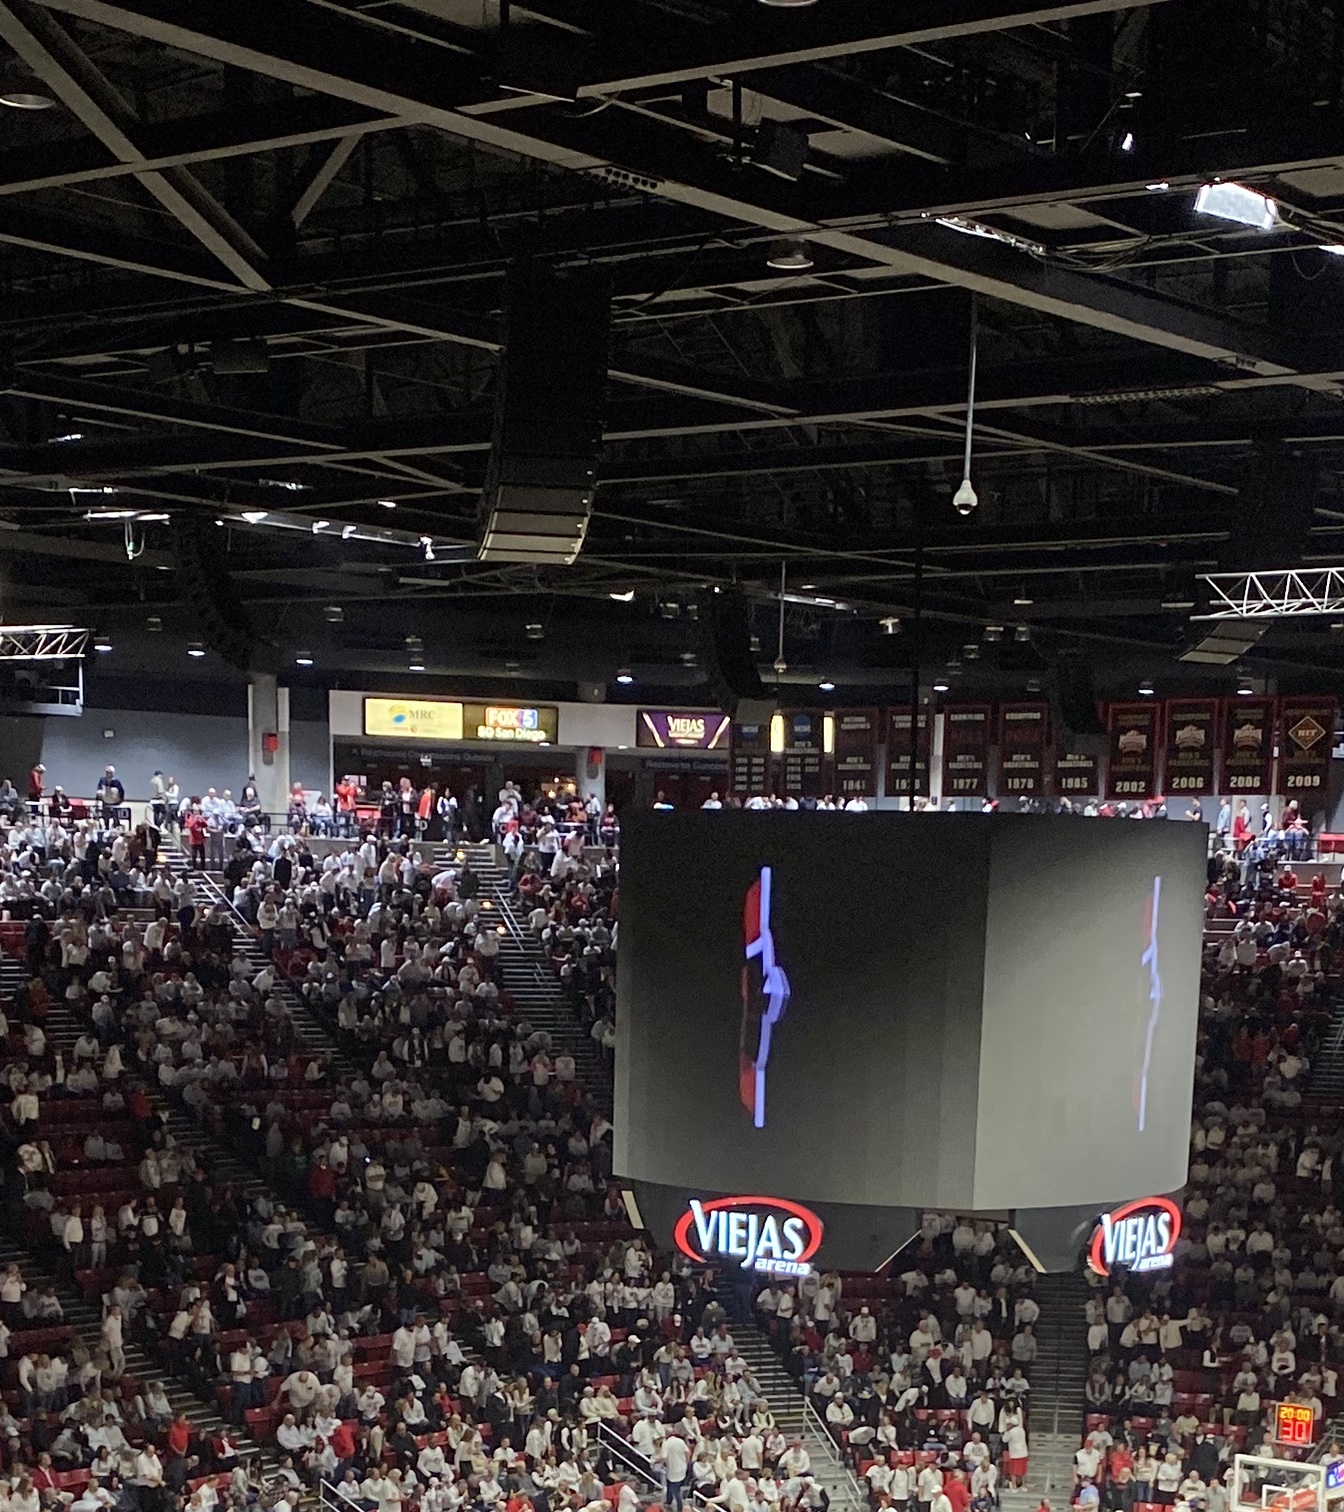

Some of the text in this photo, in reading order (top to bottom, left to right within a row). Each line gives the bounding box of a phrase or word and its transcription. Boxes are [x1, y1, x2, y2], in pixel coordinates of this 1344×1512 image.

[488, 709, 535, 727] FOX 5
[667, 716, 706, 735] VIEJAS
[495, 727, 513, 738] San
[514, 728, 546, 742] Diego
[953, 778, 978, 790] 1977
[1116, 781, 1146, 793] 2002
[1172, 777, 1204, 789] 2006
[1229, 776, 1261, 788] 2006
[1287, 775, 1321, 788] 2009
[690, 1199, 805, 1268] VIEJAS
[1101, 1212, 1171, 1272] VIEJAS
[754, 1257, 812, 1276] arena
[1279, 1406, 1311, 1421] 20:00
[1280, 1420, 1307, 1441] 30
